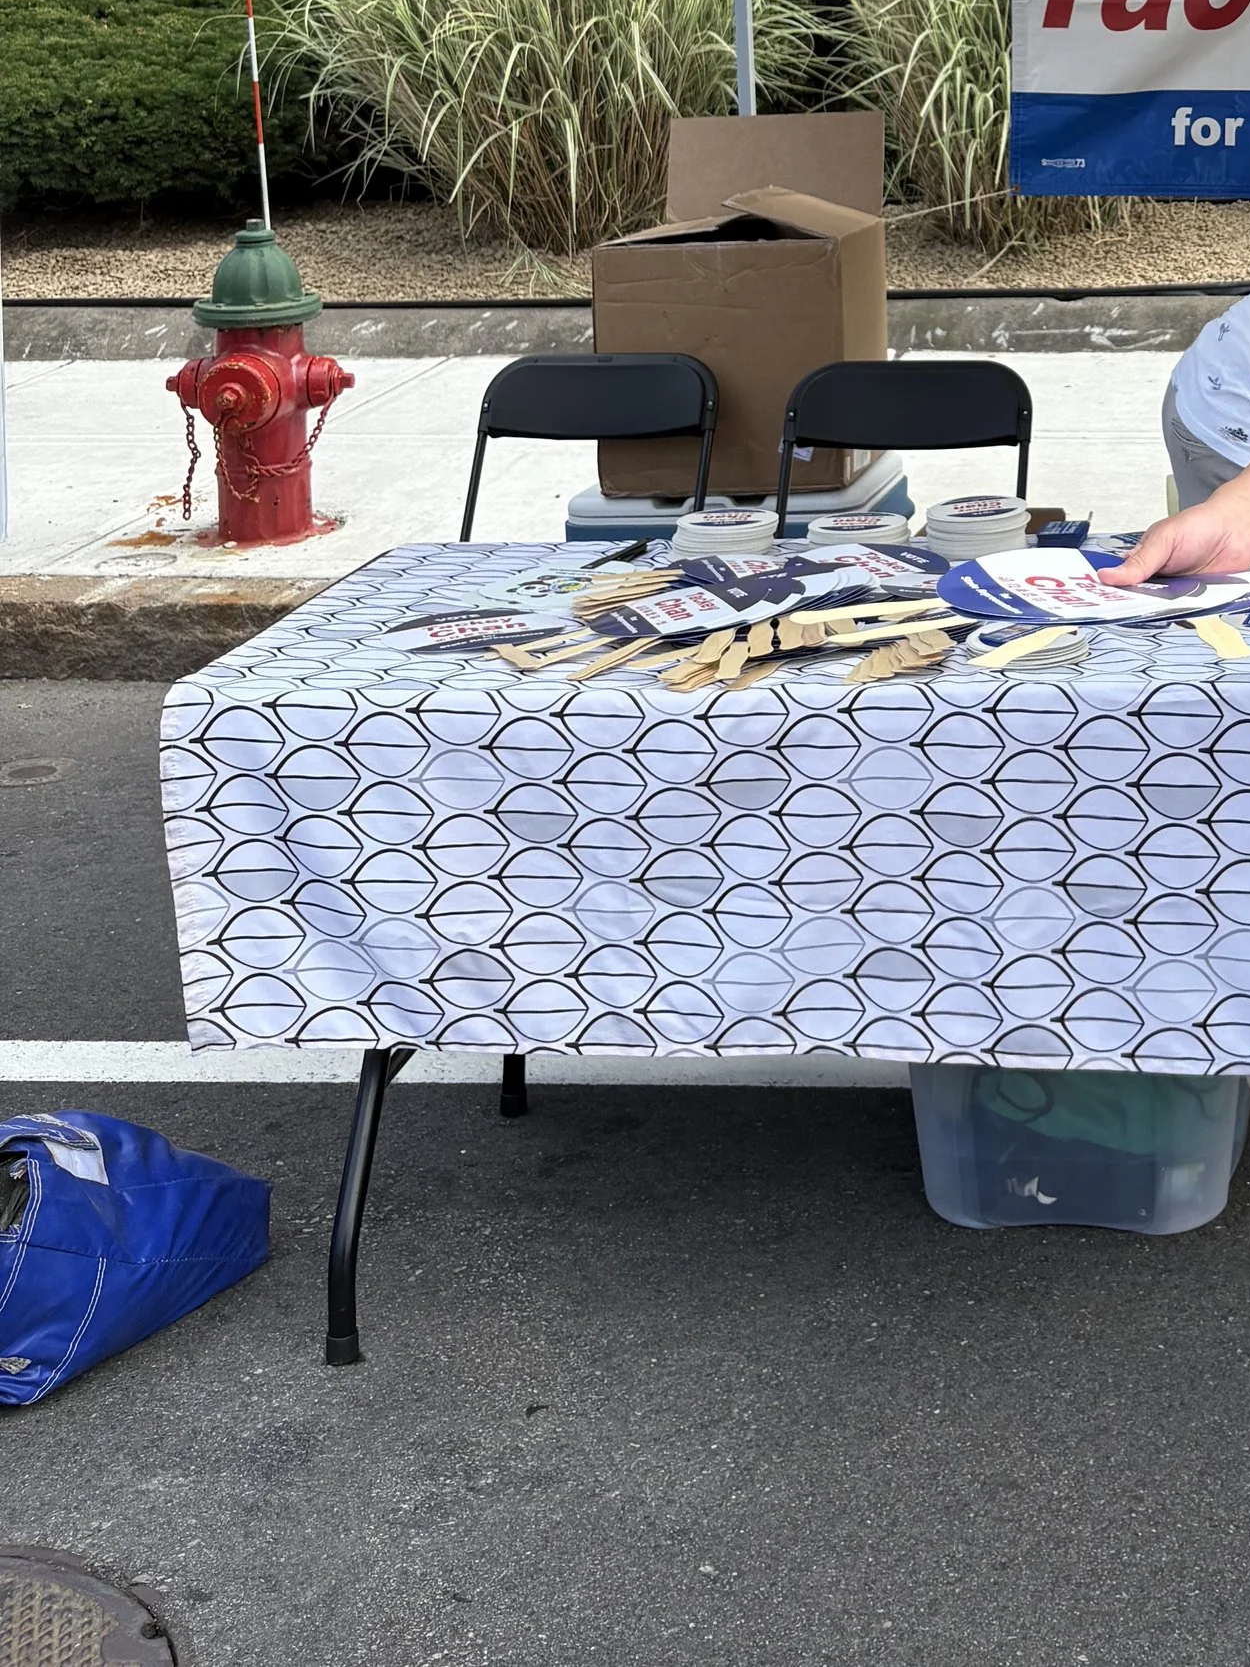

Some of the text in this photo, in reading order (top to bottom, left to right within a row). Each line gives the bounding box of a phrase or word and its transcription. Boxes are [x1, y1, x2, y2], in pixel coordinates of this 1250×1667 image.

[1171, 106, 1245, 146] for
[1024, 576, 1101, 608] Chan
[1068, 573, 1136, 601] Tackey
[654, 597, 695, 622] Chan
[429, 621, 527, 639] Chan
